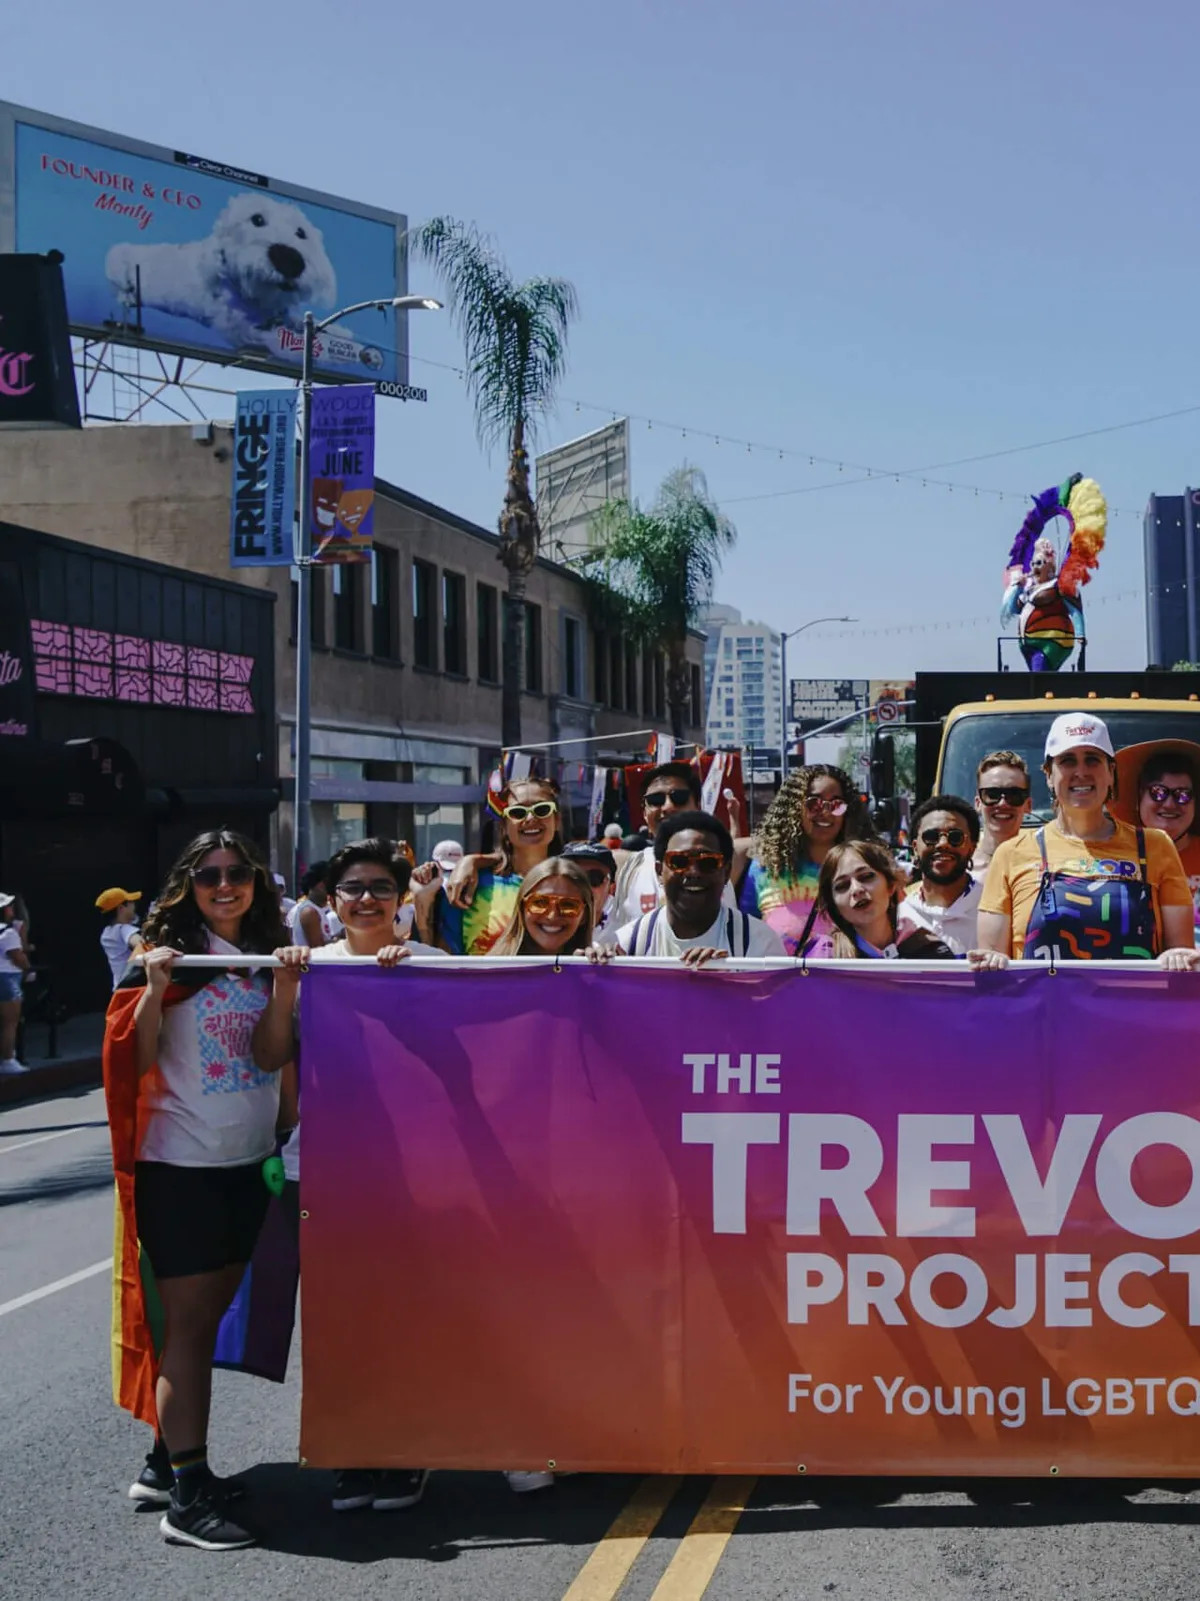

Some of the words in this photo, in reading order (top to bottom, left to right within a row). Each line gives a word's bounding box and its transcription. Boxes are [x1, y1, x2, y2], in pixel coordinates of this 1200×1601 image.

[41, 153, 135, 194] FOUNDER
[142, 180, 155, 199] &
[162, 187, 202, 210] CEO
[95, 191, 155, 230] Monty
[239, 398, 297, 414] HOLLY
[312, 394, 374, 413] WOOD
[320, 450, 364, 477] JUNE
[234, 414, 271, 558] FRINGE
[204, 1010, 263, 1037] SUPPO
[682, 1053, 782, 1094] THE
[787, 1373, 863, 1414] For
[873, 1375, 1028, 1428] Young
